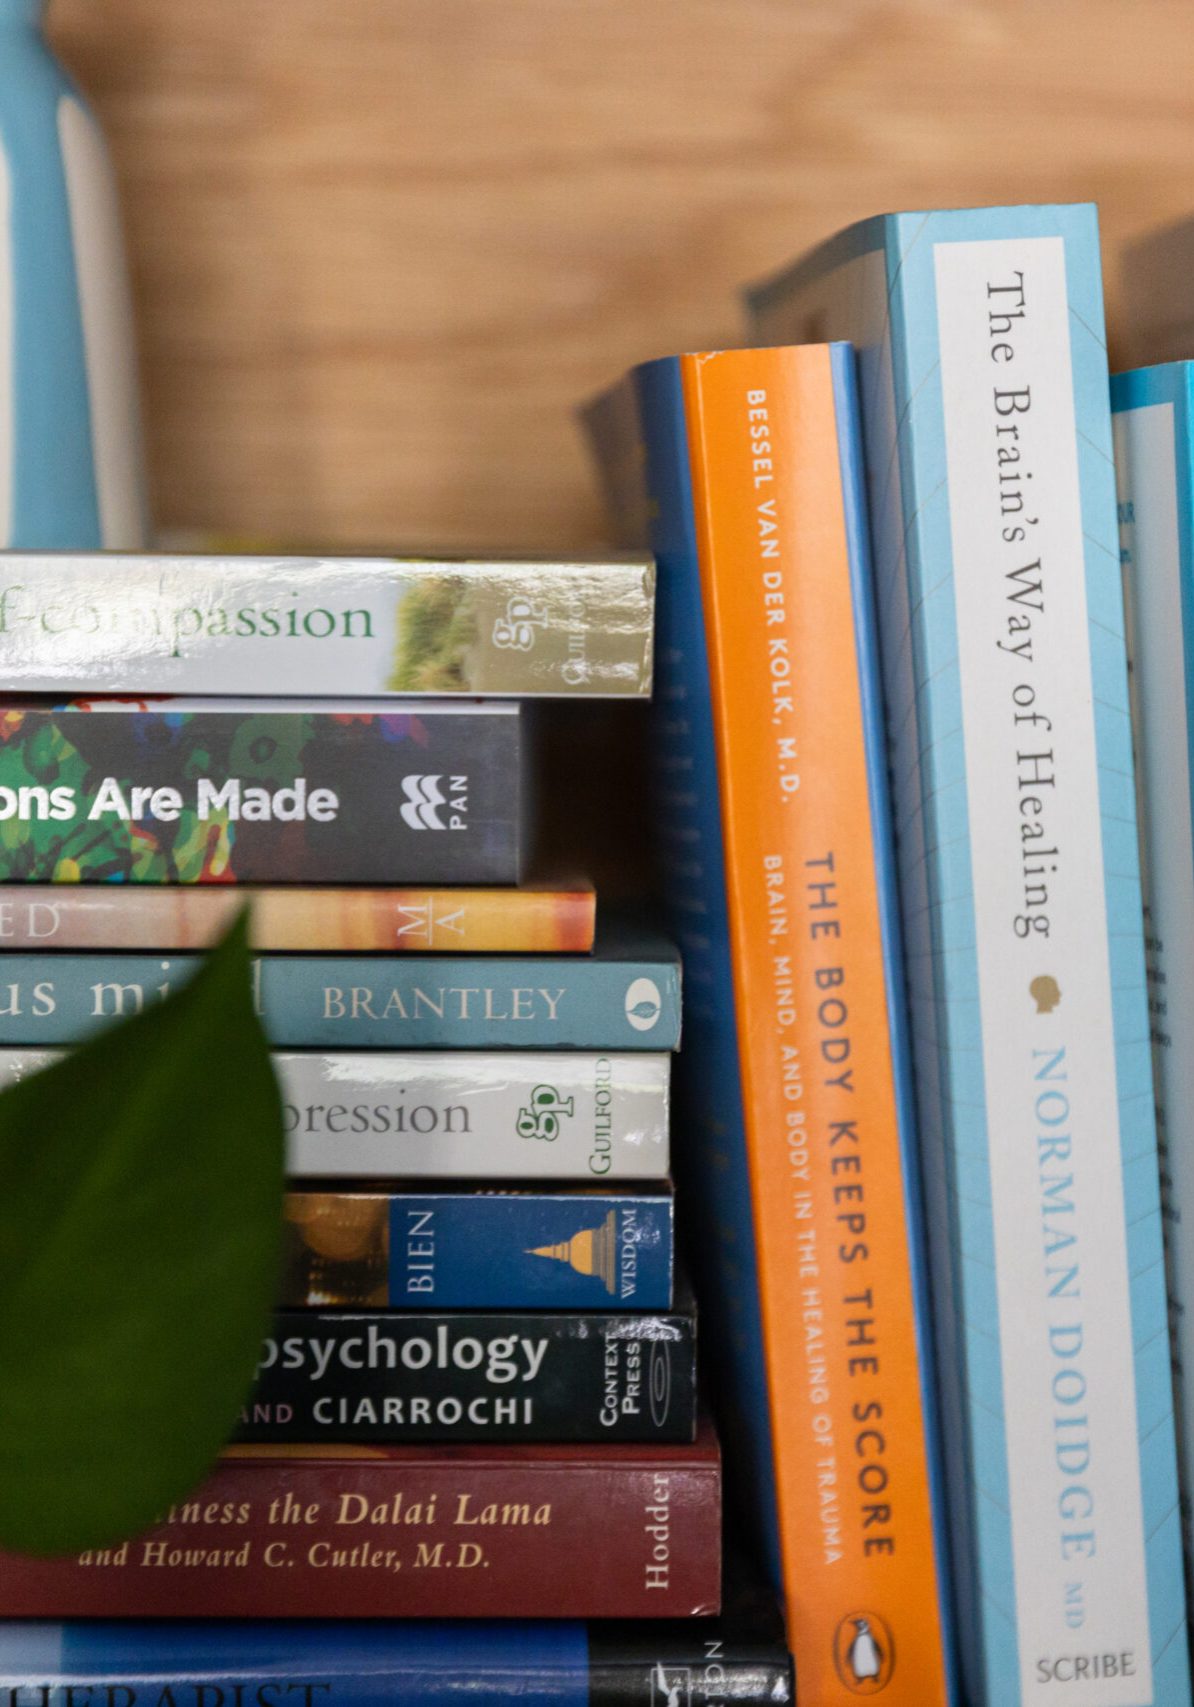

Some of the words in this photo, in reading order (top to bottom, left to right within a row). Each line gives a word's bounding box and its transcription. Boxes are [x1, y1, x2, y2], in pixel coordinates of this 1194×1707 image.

[986, 270, 1026, 364] The
[747, 388, 774, 488] BESSEL
[993, 384, 1040, 543] Brain's
[757, 500, 780, 558] VAN
[763, 571, 786, 625] DER
[997, 557, 1045, 664] Way
[768, 638, 794, 726] KOLK,
[1012, 681, 1052, 729] of
[0, 784, 77, 822] ons
[88, 776, 184, 822] Are
[196, 777, 340, 822] Made
[448, 774, 468, 831] PAN
[776, 737, 801, 803] M.D.
[1012, 748, 1064, 941] Healing
[763, 854, 788, 946] BRAIN,
[804, 851, 841, 940] THE
[0, 980, 56, 1017] us
[321, 986, 567, 1020] BRANTLEY
[773, 955, 797, 1035] MIND,
[814, 966, 855, 1094] BODY
[588, 1057, 612, 1176] GUILFORD
[781, 1045, 803, 1102] AND
[786, 1110, 811, 1182] BODY
[1030, 1045, 1081, 1305] NORMAN
[793, 1190, 815, 1220] IN
[827, 1119, 869, 1266] KEEPS
[406, 1209, 436, 1295] BIEN
[620, 1207, 638, 1300] WISDOM
[797, 1230, 821, 1279] THE
[801, 1287, 830, 1405] HEALING
[842, 1287, 879, 1378] THE
[312, 1396, 534, 1425] CIARROCHI
[599, 1331, 619, 1427] CONTEXT
[621, 1341, 641, 1415] PRESS
[811, 1415, 836, 1447] OF
[1048, 1321, 1097, 1563] DOIDGE
[268, 1491, 321, 1525] the
[335, 1492, 439, 1526] Dalai
[454, 1492, 553, 1526] Lama
[816, 1460, 844, 1567] TRAUMA
[852, 1402, 895, 1558] SCORE
[78, 1541, 129, 1567] and
[140, 1540, 251, 1568] Howard
[263, 1541, 295, 1568] C.
[307, 1541, 402, 1573] Cutler,
[412, 1542, 491, 1569] M.D.
[645, 1470, 670, 1591] Hodder
[1064, 1582, 1087, 1630] MD
[1036, 1650, 1139, 1685] SCRIBE
